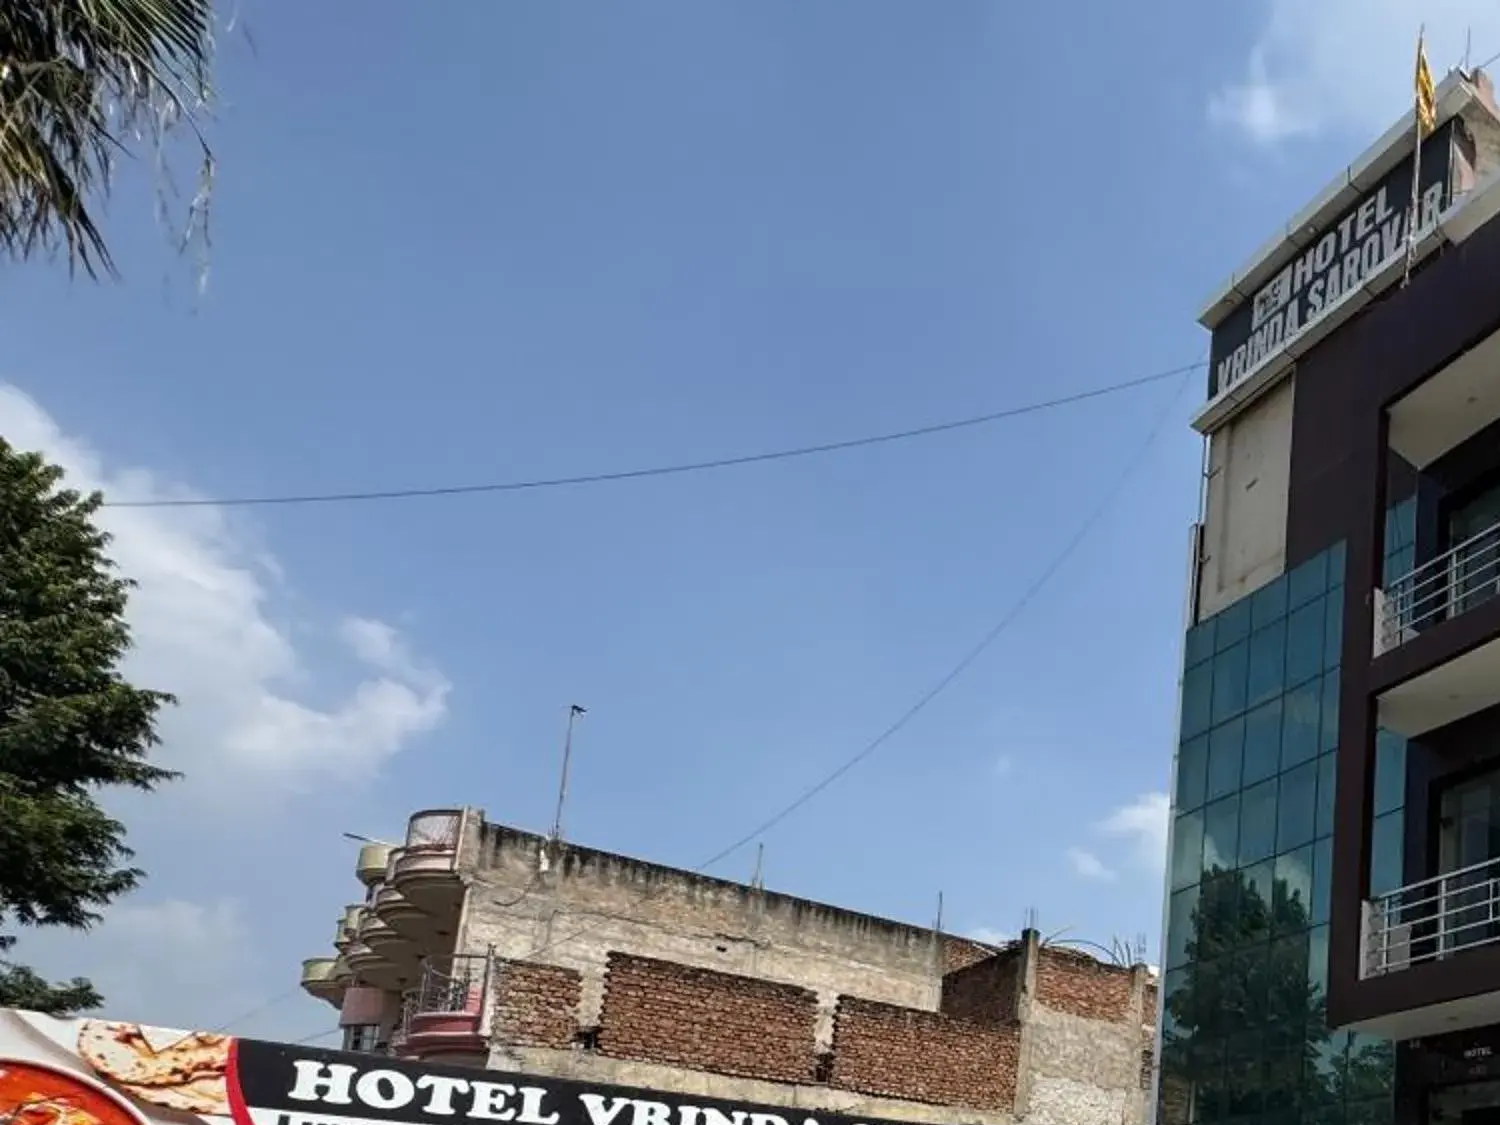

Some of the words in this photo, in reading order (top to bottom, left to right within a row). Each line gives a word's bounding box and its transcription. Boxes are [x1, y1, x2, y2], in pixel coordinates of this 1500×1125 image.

[1291, 185, 1394, 294] HOTEL
[1217, 299, 1300, 394] VRINDA
[287, 1059, 560, 1125] HOTEL
